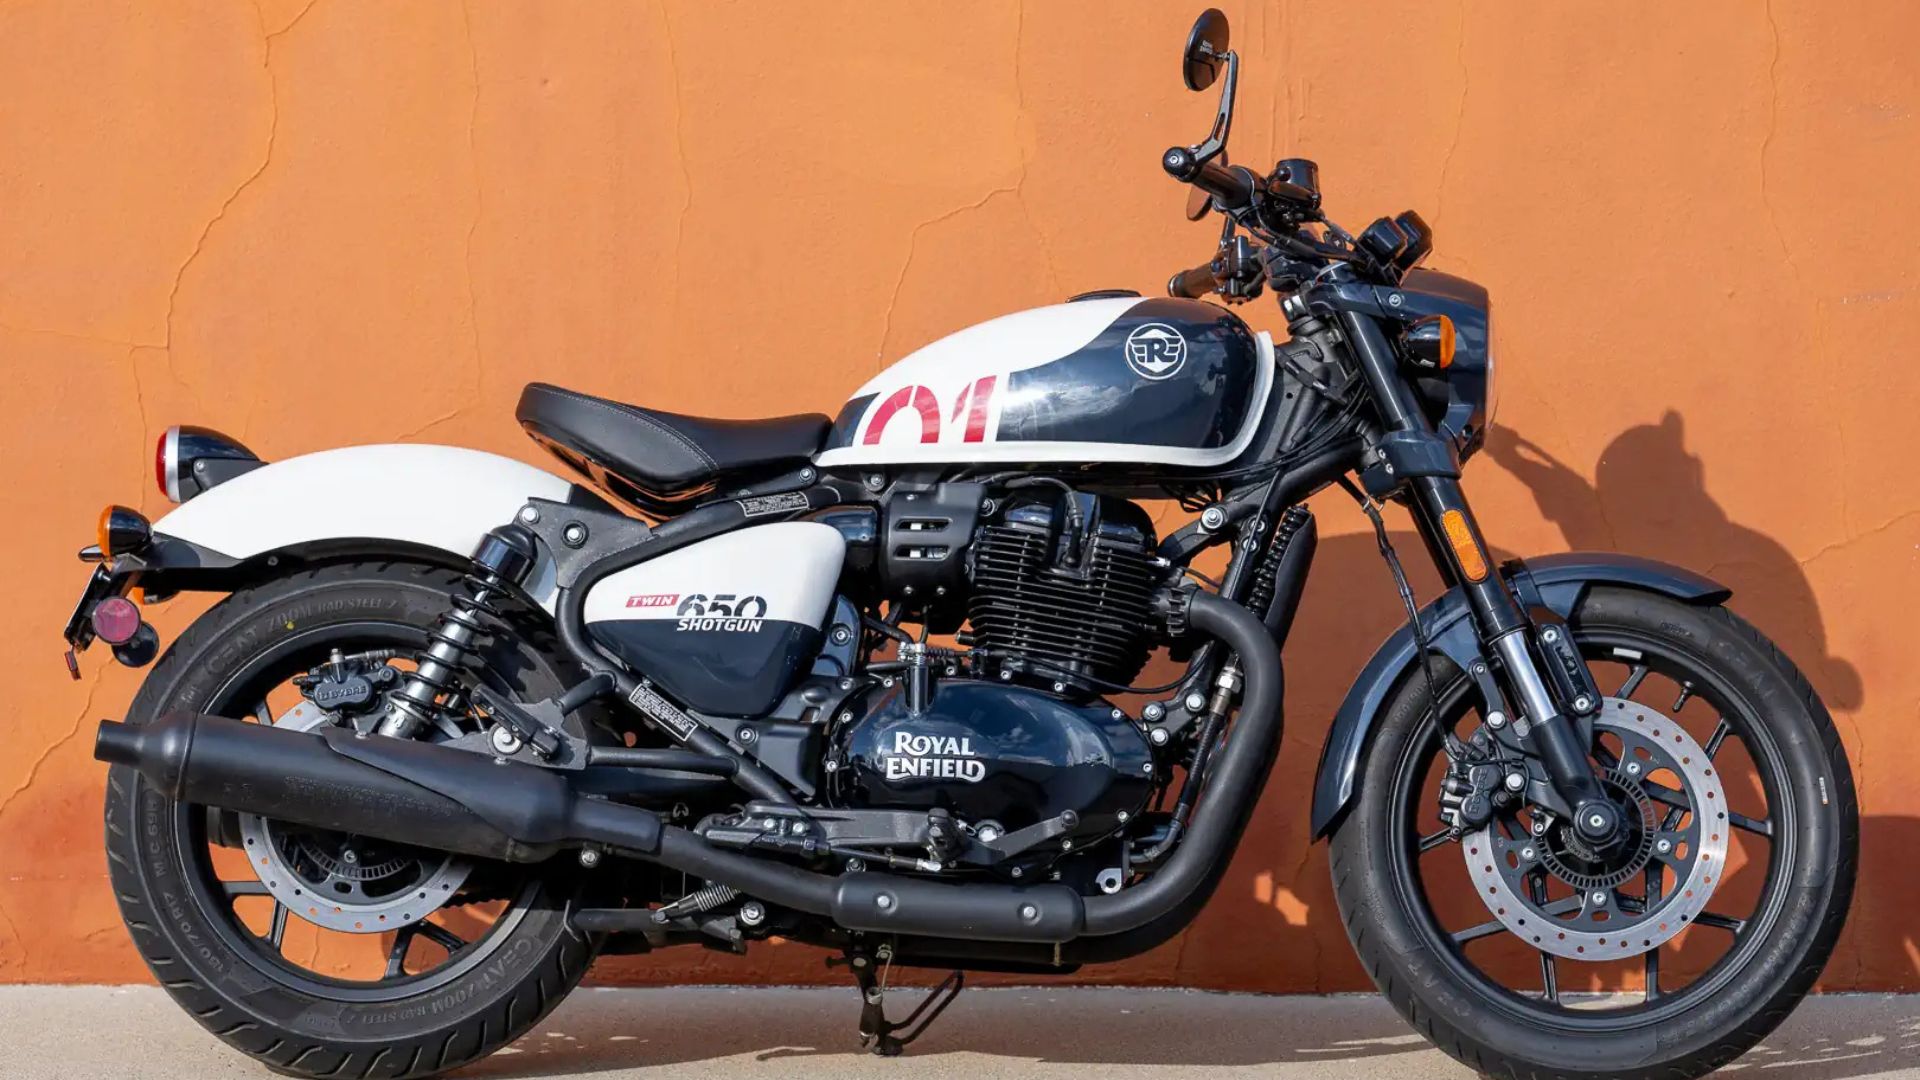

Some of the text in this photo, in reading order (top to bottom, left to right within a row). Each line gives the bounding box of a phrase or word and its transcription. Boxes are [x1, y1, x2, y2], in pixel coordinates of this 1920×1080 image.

[630, 593, 767, 618] TWIN 650
[206, 624, 259, 676] CEAT
[266, 603, 314, 630] ZOOM
[316, 599, 343, 613] RAD
[676, 619, 763, 632] SHOTGUN
[894, 731, 975, 756] ROYAL
[886, 757, 986, 783] ENFIELD
[480, 936, 533, 990] CEAT
[430, 983, 477, 1015] ZOOM
